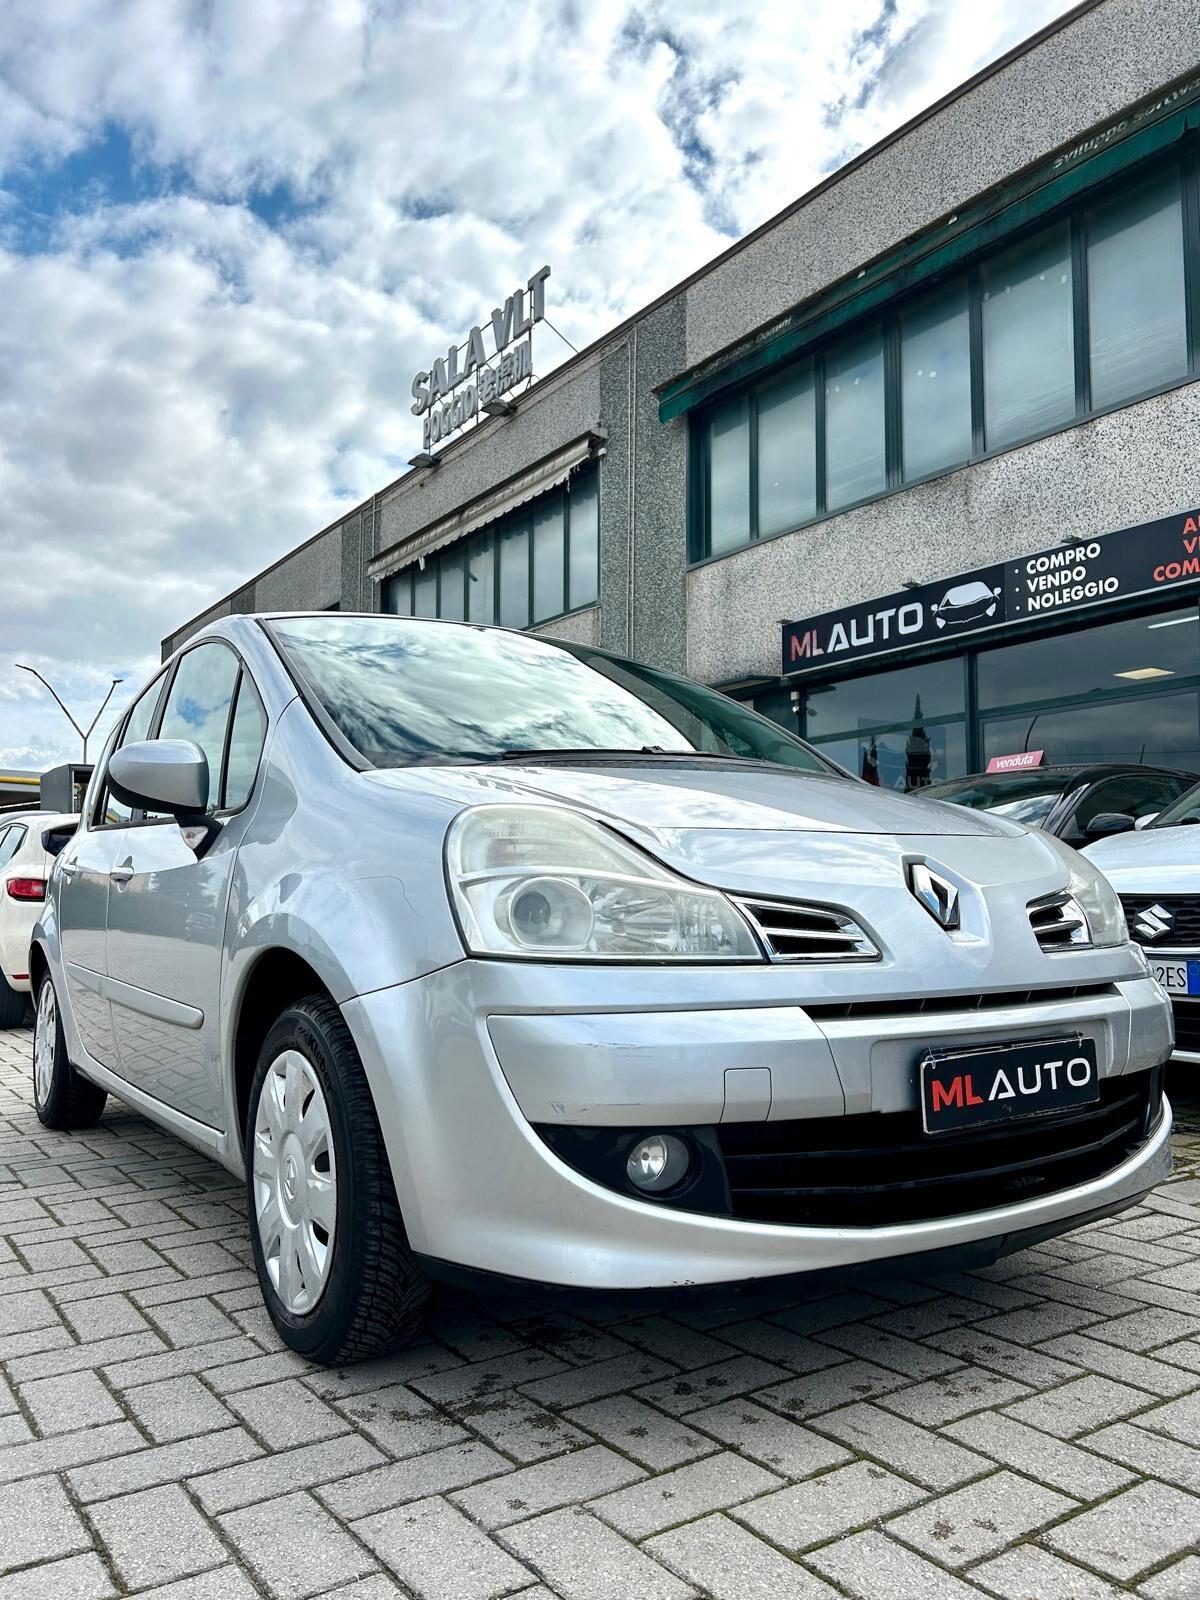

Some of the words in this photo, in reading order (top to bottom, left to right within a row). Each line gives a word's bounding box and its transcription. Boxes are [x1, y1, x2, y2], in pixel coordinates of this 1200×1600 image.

[411, 326, 487, 416] SALA
[491, 265, 551, 352] VLT
[423, 384, 478, 450] POGGIO
[1026, 542, 1101, 575] COMPRO
[1026, 565, 1087, 593] VENDO
[1027, 577, 1119, 612] NOLEGGIO
[996, 754, 1034, 769] venduta
[988, 1057, 1092, 1101] AUTO
